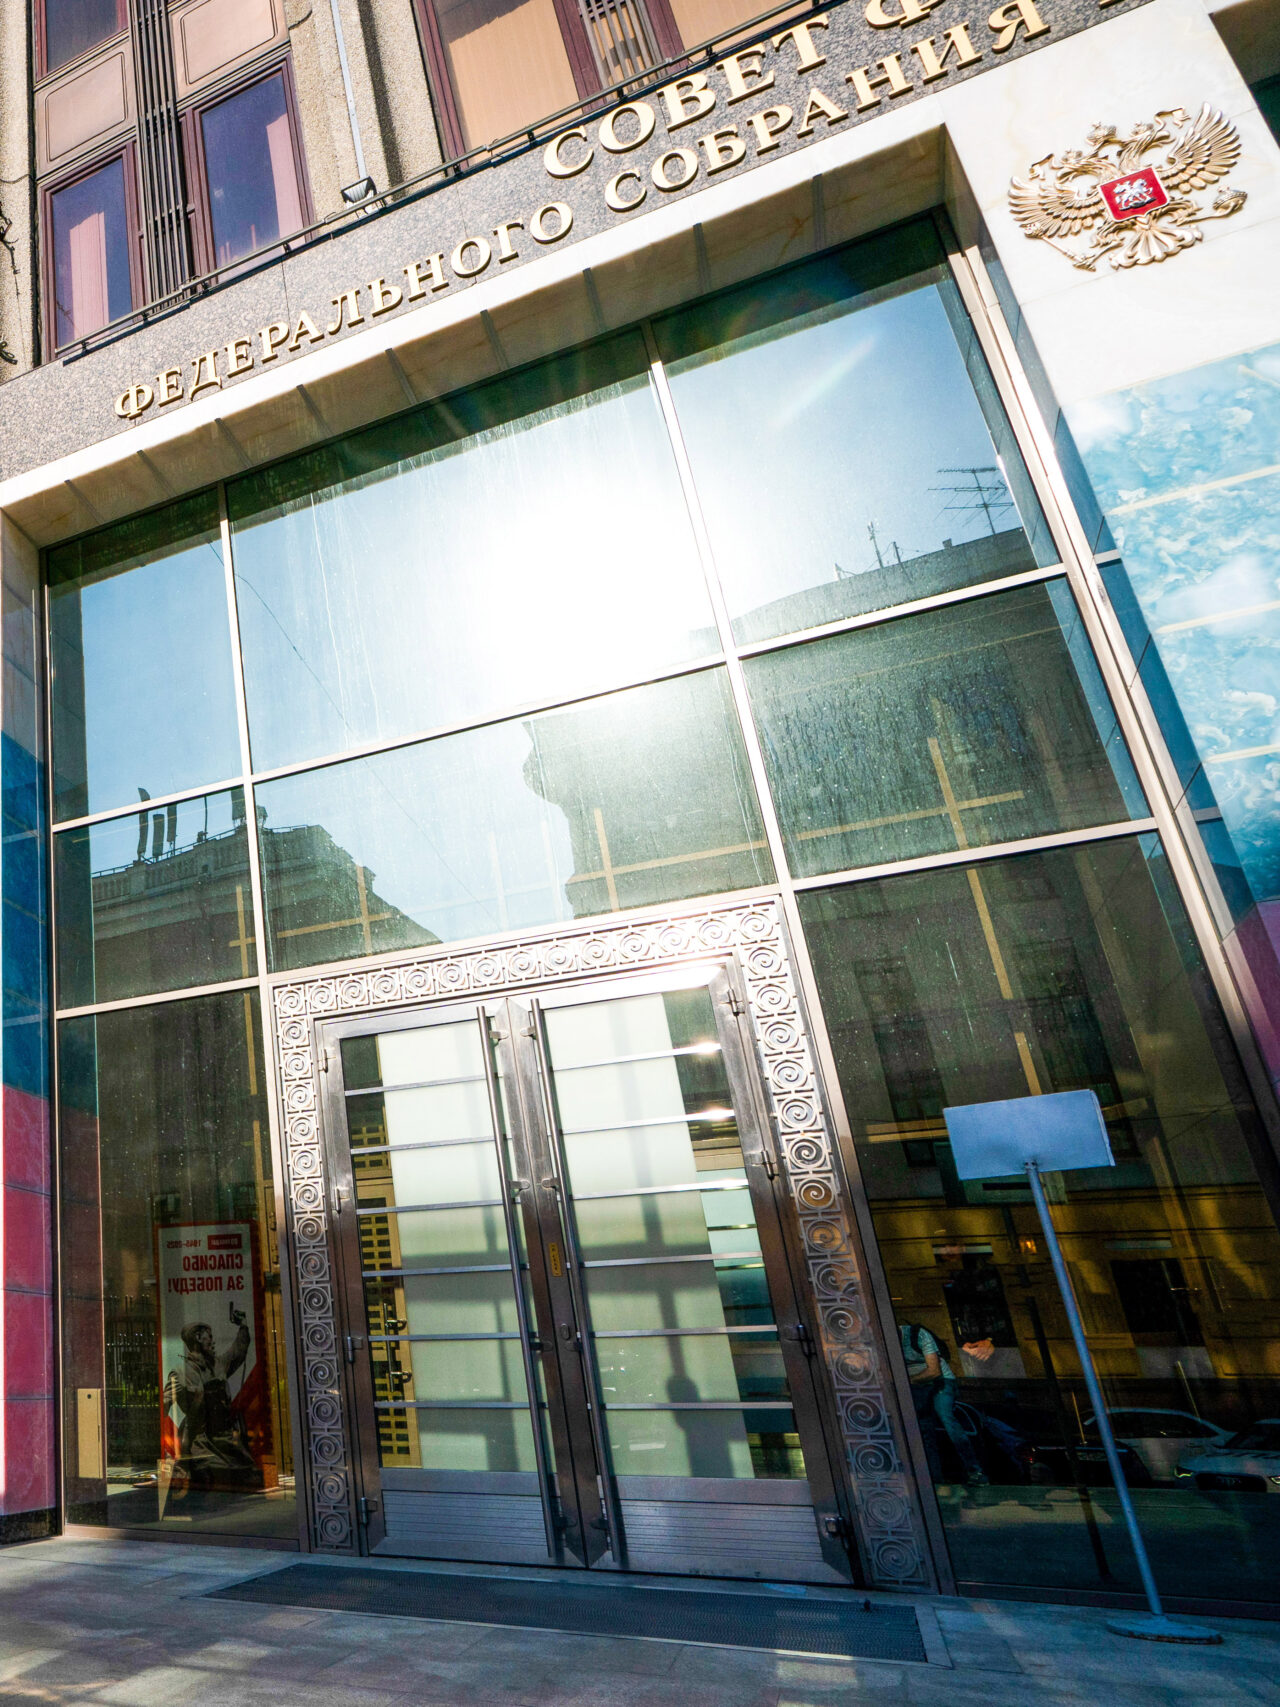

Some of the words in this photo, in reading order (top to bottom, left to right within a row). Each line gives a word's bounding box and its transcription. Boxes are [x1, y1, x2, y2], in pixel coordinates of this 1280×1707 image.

[116, 201, 573, 419] ФЕДЕРАЛЬНОГО
[605, 0, 1051, 212] СОБРАНИЯ
[545, 16, 828, 178] СОВЕТ
